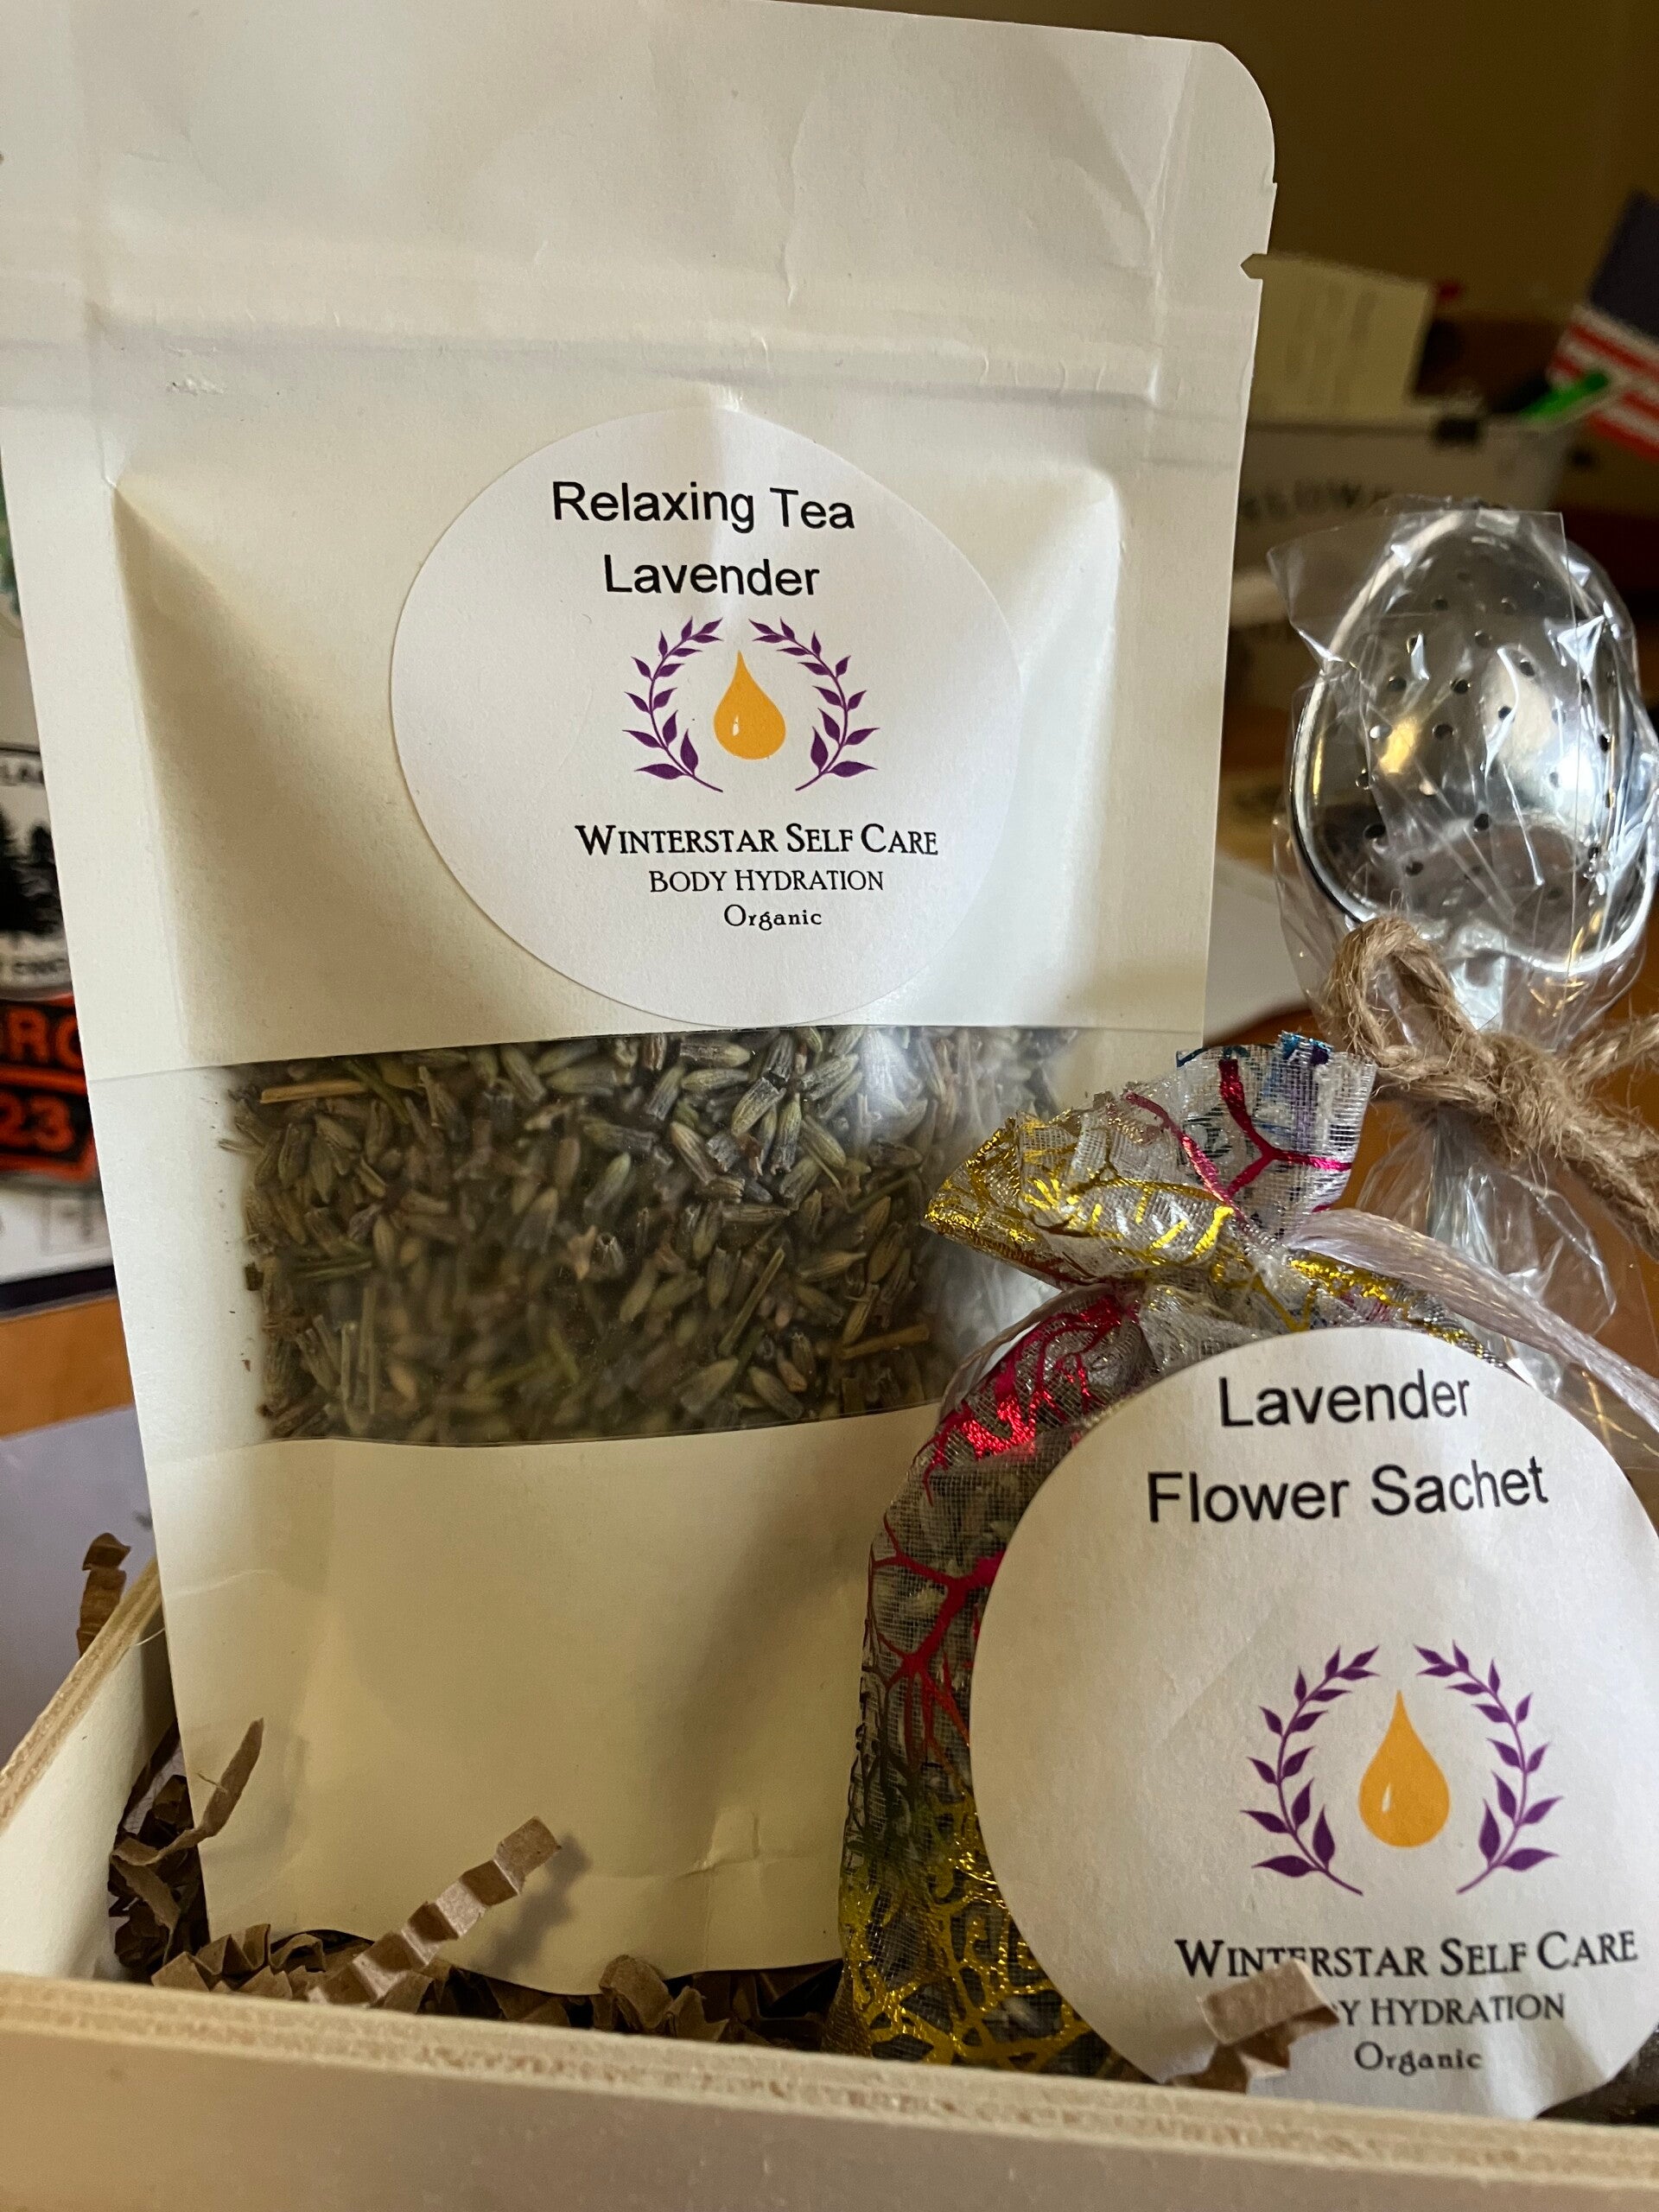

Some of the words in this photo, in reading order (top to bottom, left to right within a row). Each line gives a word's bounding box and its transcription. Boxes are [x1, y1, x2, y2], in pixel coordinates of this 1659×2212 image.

[552, 480, 754, 534] Relaxing
[769, 486, 855, 530] Tea
[603, 554, 821, 597] Lavender
[575, 824, 779, 856] WINTERSTAR
[785, 823, 854, 854] SELF
[860, 823, 939, 856] CARE
[648, 870, 728, 893] BODY
[734, 868, 884, 892] HYDRATION
[723, 904, 823, 931] Organic
[1218, 1368, 1471, 1428] Lavender
[1147, 1471, 1351, 1524] Flower
[1370, 1455, 1549, 1516] Sachet
[1440, 1937, 1528, 1978] SELF
[1536, 1930, 1638, 1973] CARE
[1370, 1993, 1565, 2026] HYDRATION
[1354, 2041, 1482, 2076] Organic
